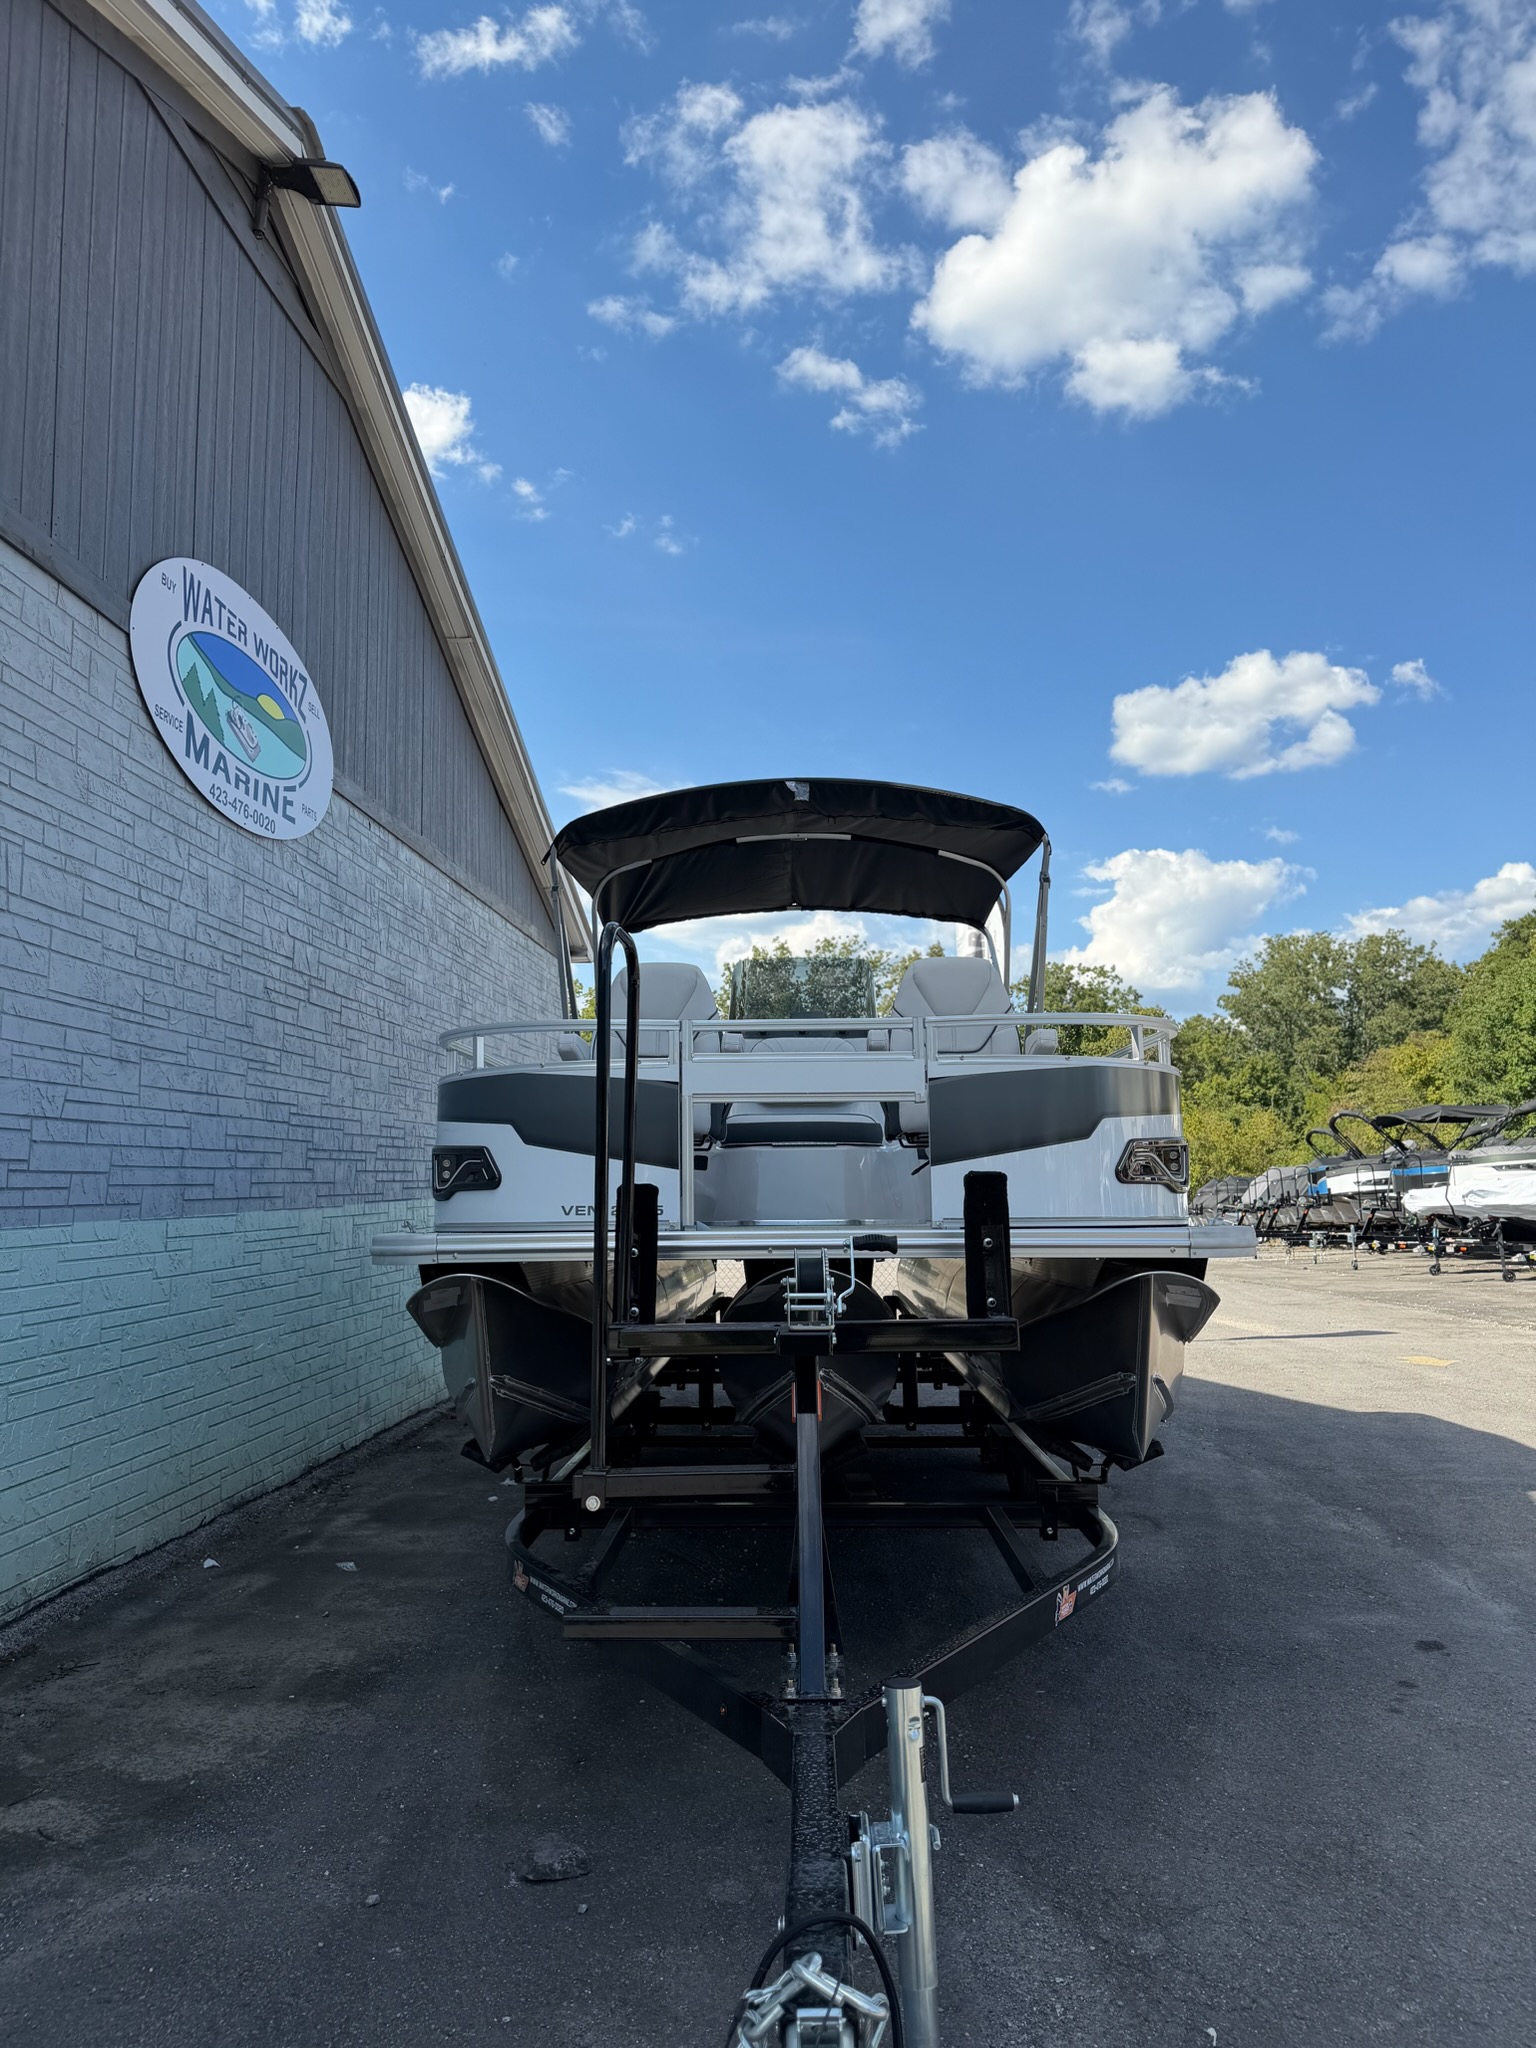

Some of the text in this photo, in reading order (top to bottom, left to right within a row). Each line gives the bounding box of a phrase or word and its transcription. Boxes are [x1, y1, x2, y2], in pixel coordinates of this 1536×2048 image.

[161, 572, 177, 594] BUY
[183, 565, 308, 724] WATER WORKZ
[154, 704, 183, 733] SERVICE
[307, 701, 320, 720] SELL
[185, 709, 297, 825] MARINE
[209, 783, 276, 834] 423-476-0020
[301, 803, 317, 822] PARTS
